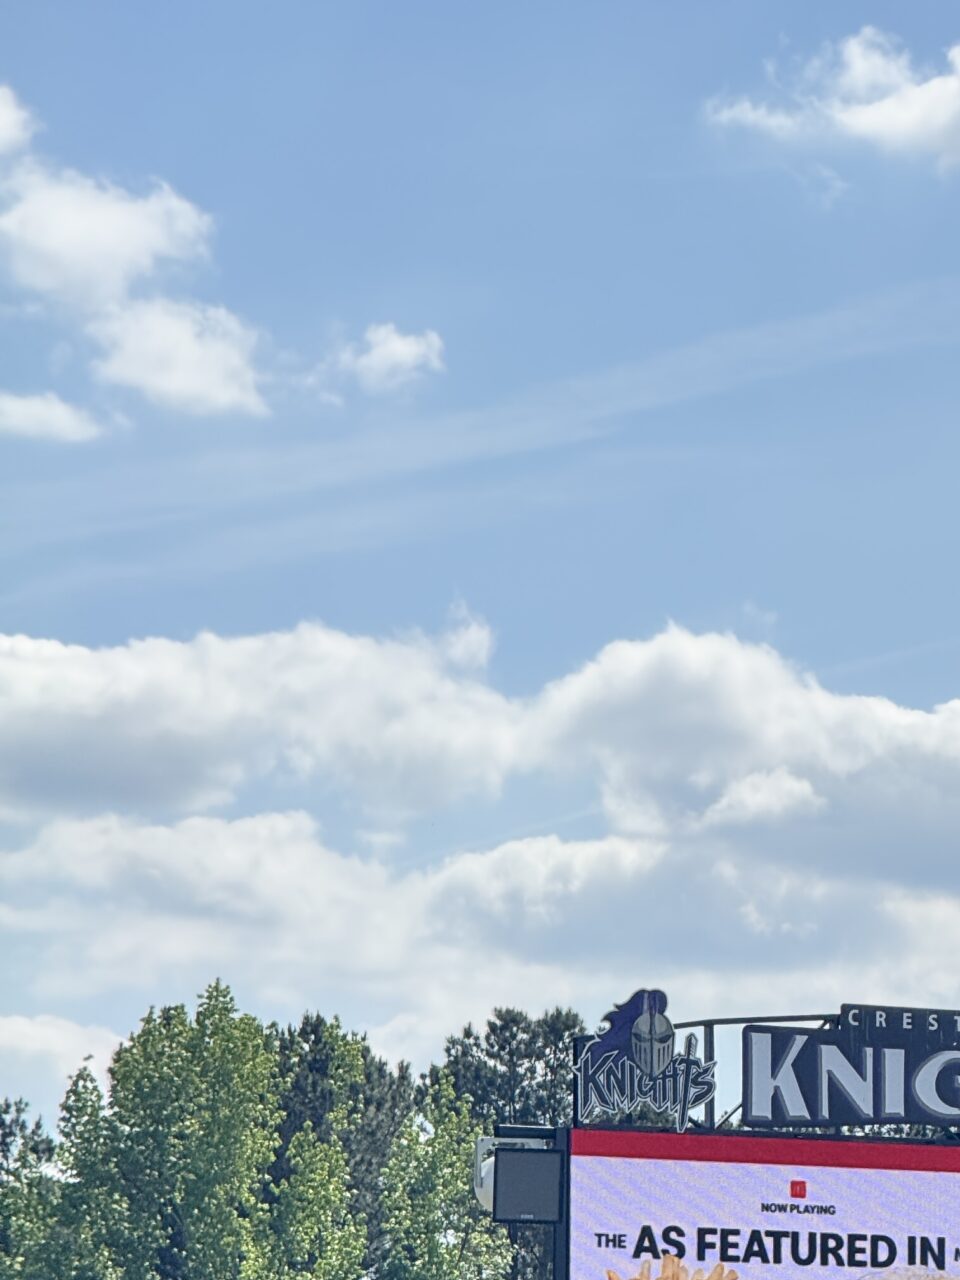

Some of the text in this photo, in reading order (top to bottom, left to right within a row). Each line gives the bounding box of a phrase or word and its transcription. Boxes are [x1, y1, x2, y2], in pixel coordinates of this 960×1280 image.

[761, 1202, 836, 1215] NOW PLAYING
[594, 1233, 627, 1250] THE
[632, 1225, 687, 1260] AS
[697, 1227, 897, 1268] FEATURED
[907, 1235, 946, 1271] IN
